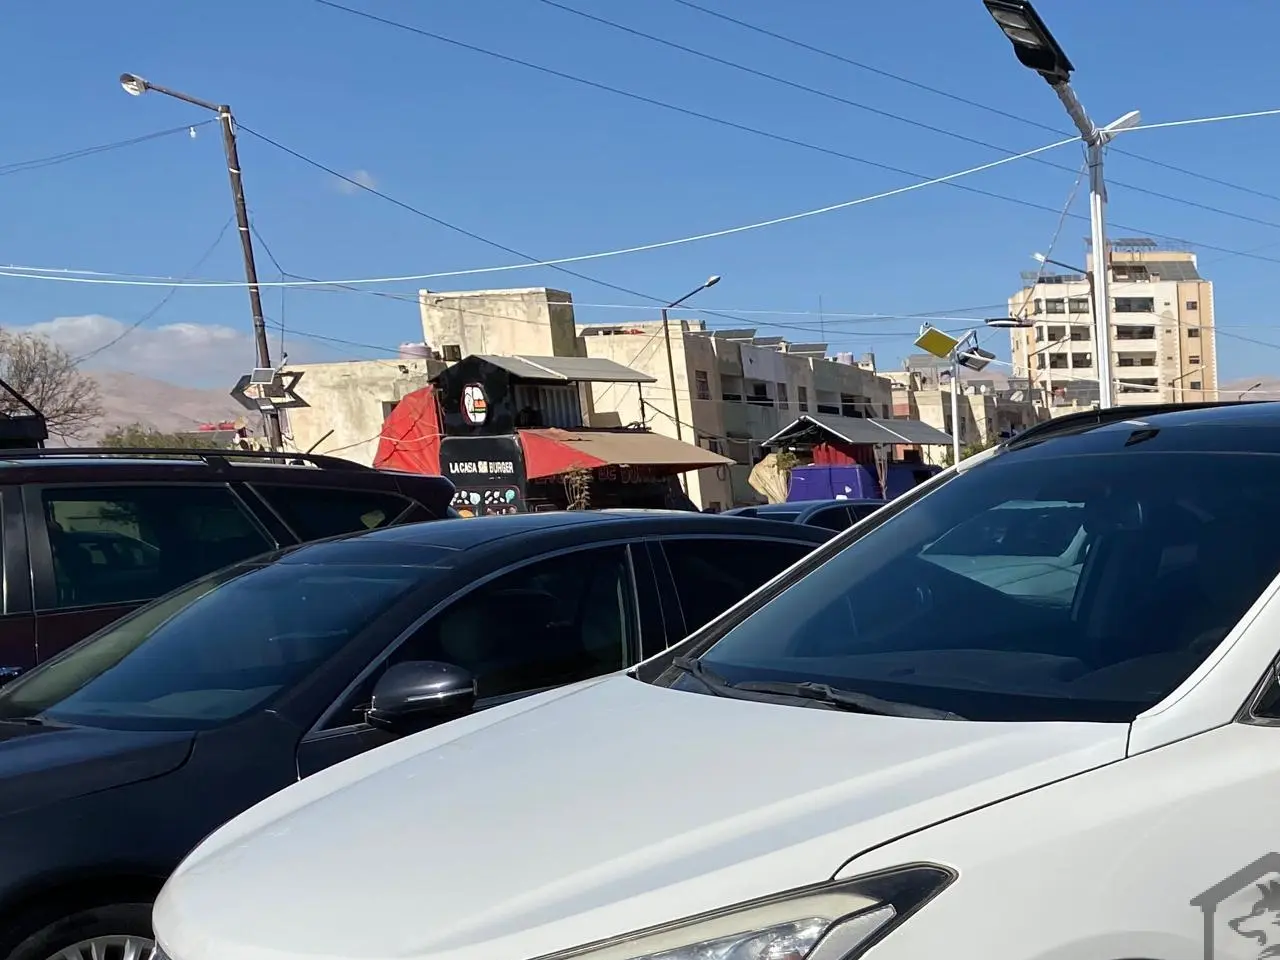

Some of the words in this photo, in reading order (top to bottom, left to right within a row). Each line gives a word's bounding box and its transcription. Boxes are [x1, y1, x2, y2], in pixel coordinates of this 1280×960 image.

[449, 463, 460, 473] LA
[460, 463, 477, 473] CASA
[489, 462, 514, 473] BURGER
